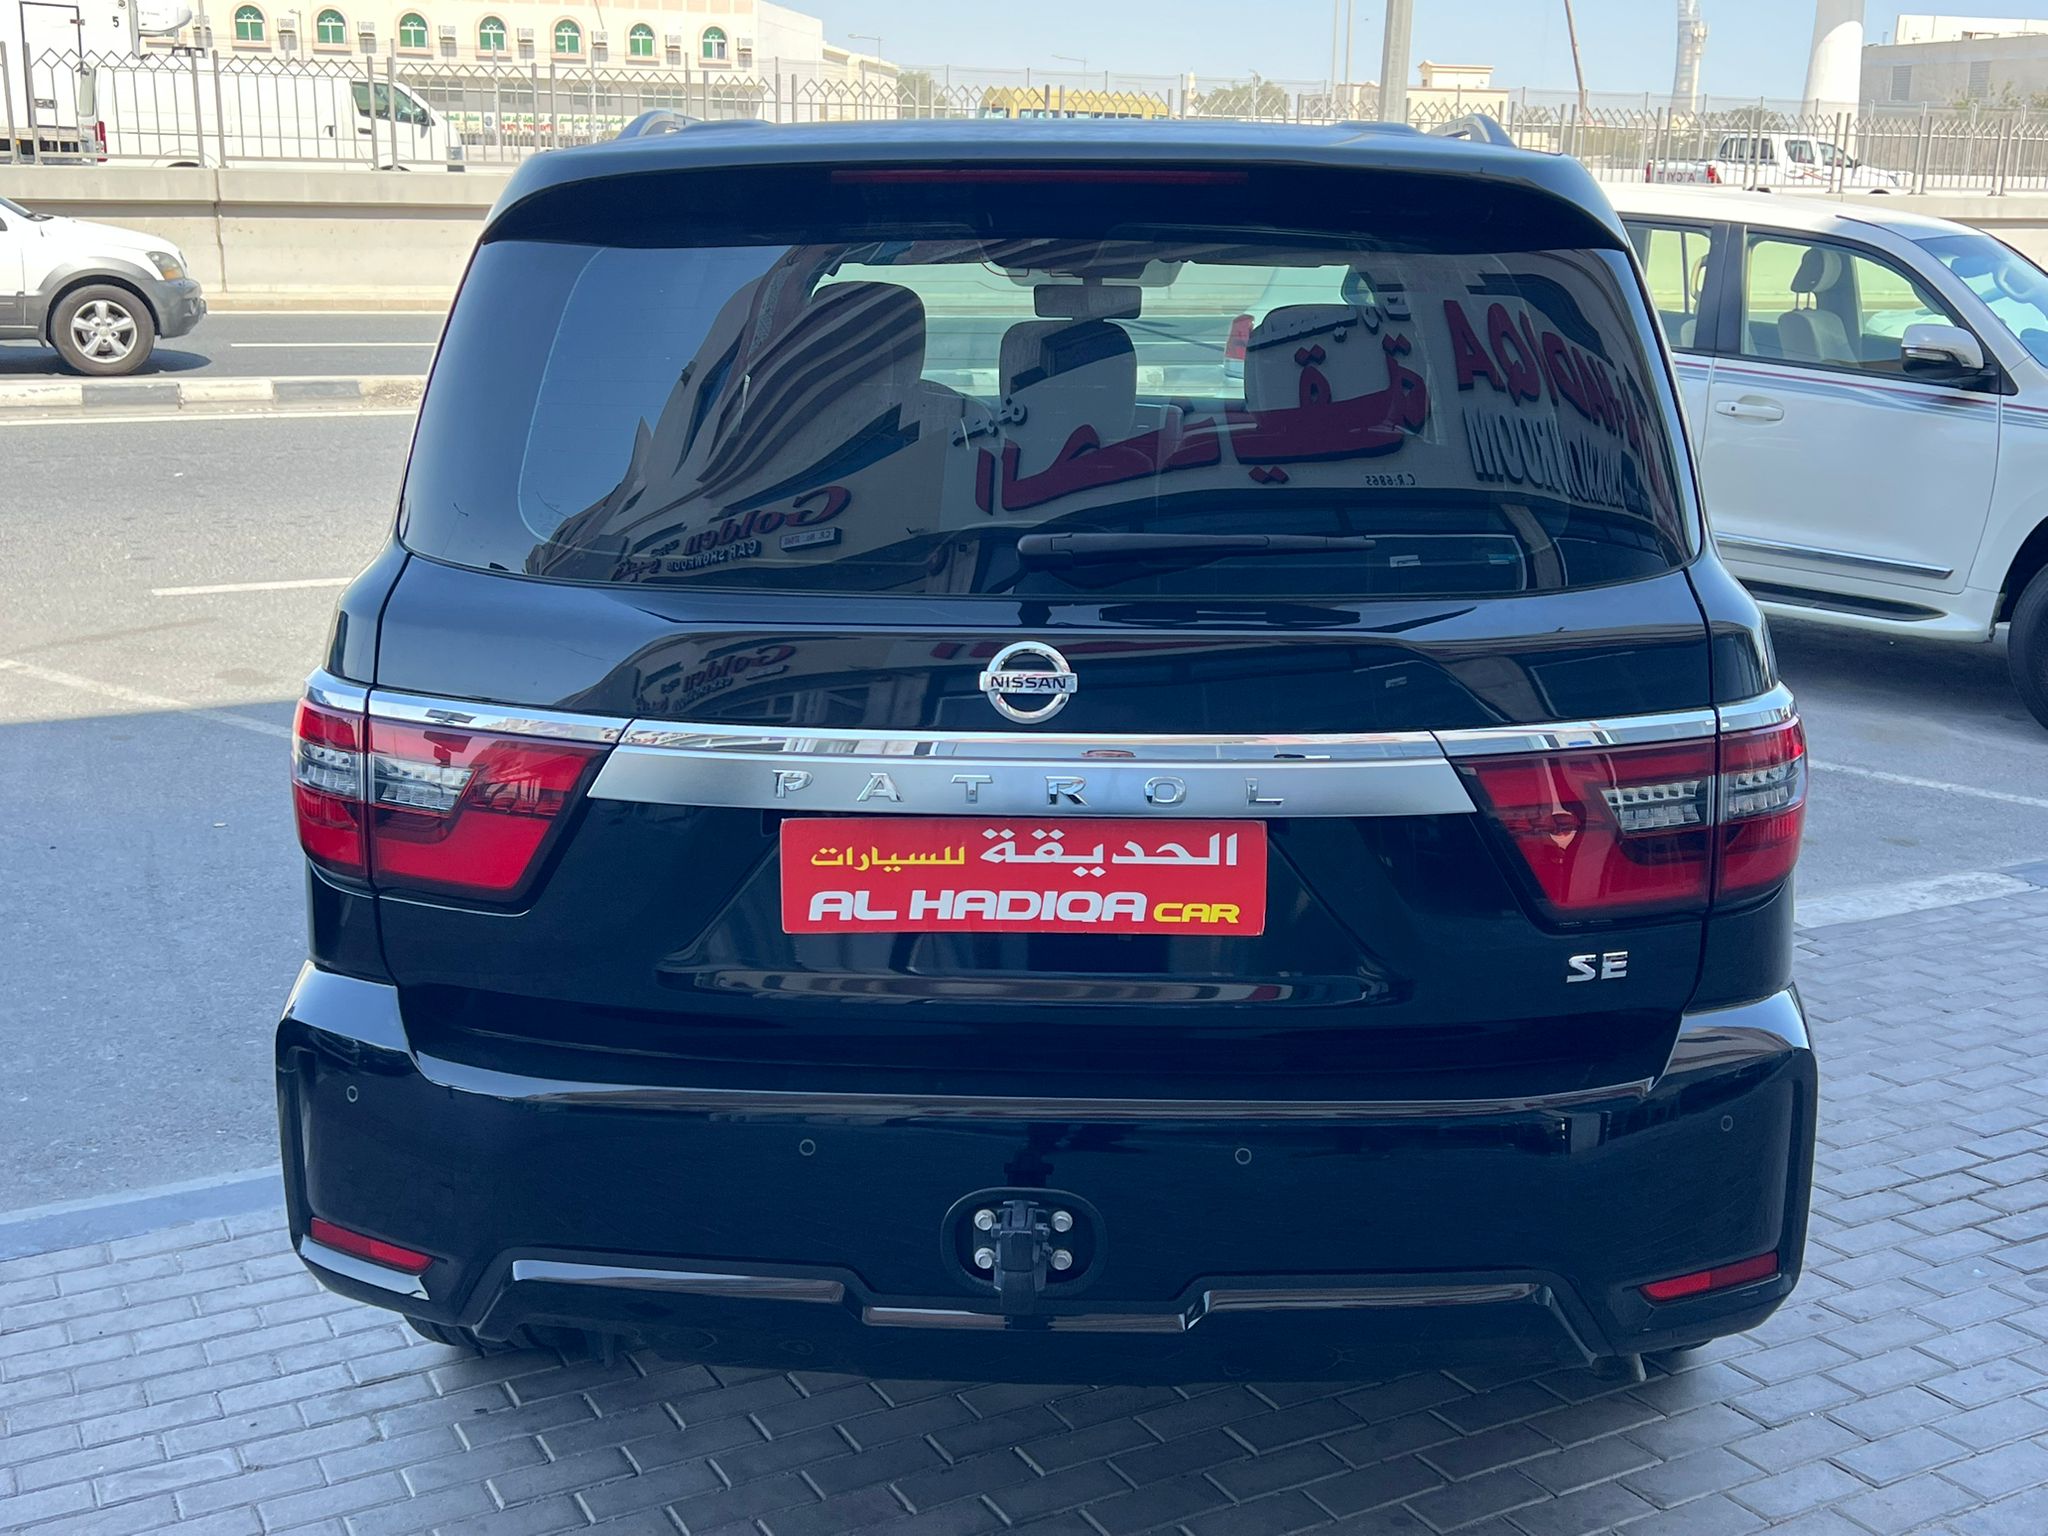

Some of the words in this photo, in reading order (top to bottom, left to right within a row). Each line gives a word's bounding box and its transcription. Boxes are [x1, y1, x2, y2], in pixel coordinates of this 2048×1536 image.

[112, 16, 120, 28] 5
[1657, 171, 1696, 183] TYOA
[991, 674, 1067, 691] NISSAN
[773, 769, 1285, 807] PATROL
[810, 846, 966, 873] للسيارات
[979, 828, 1238, 878] الحديقة
[808, 890, 897, 922] AL
[909, 889, 1148, 923] HADIQA
[1153, 903, 1241, 924] CAR
[1566, 950, 1628, 983] SE
